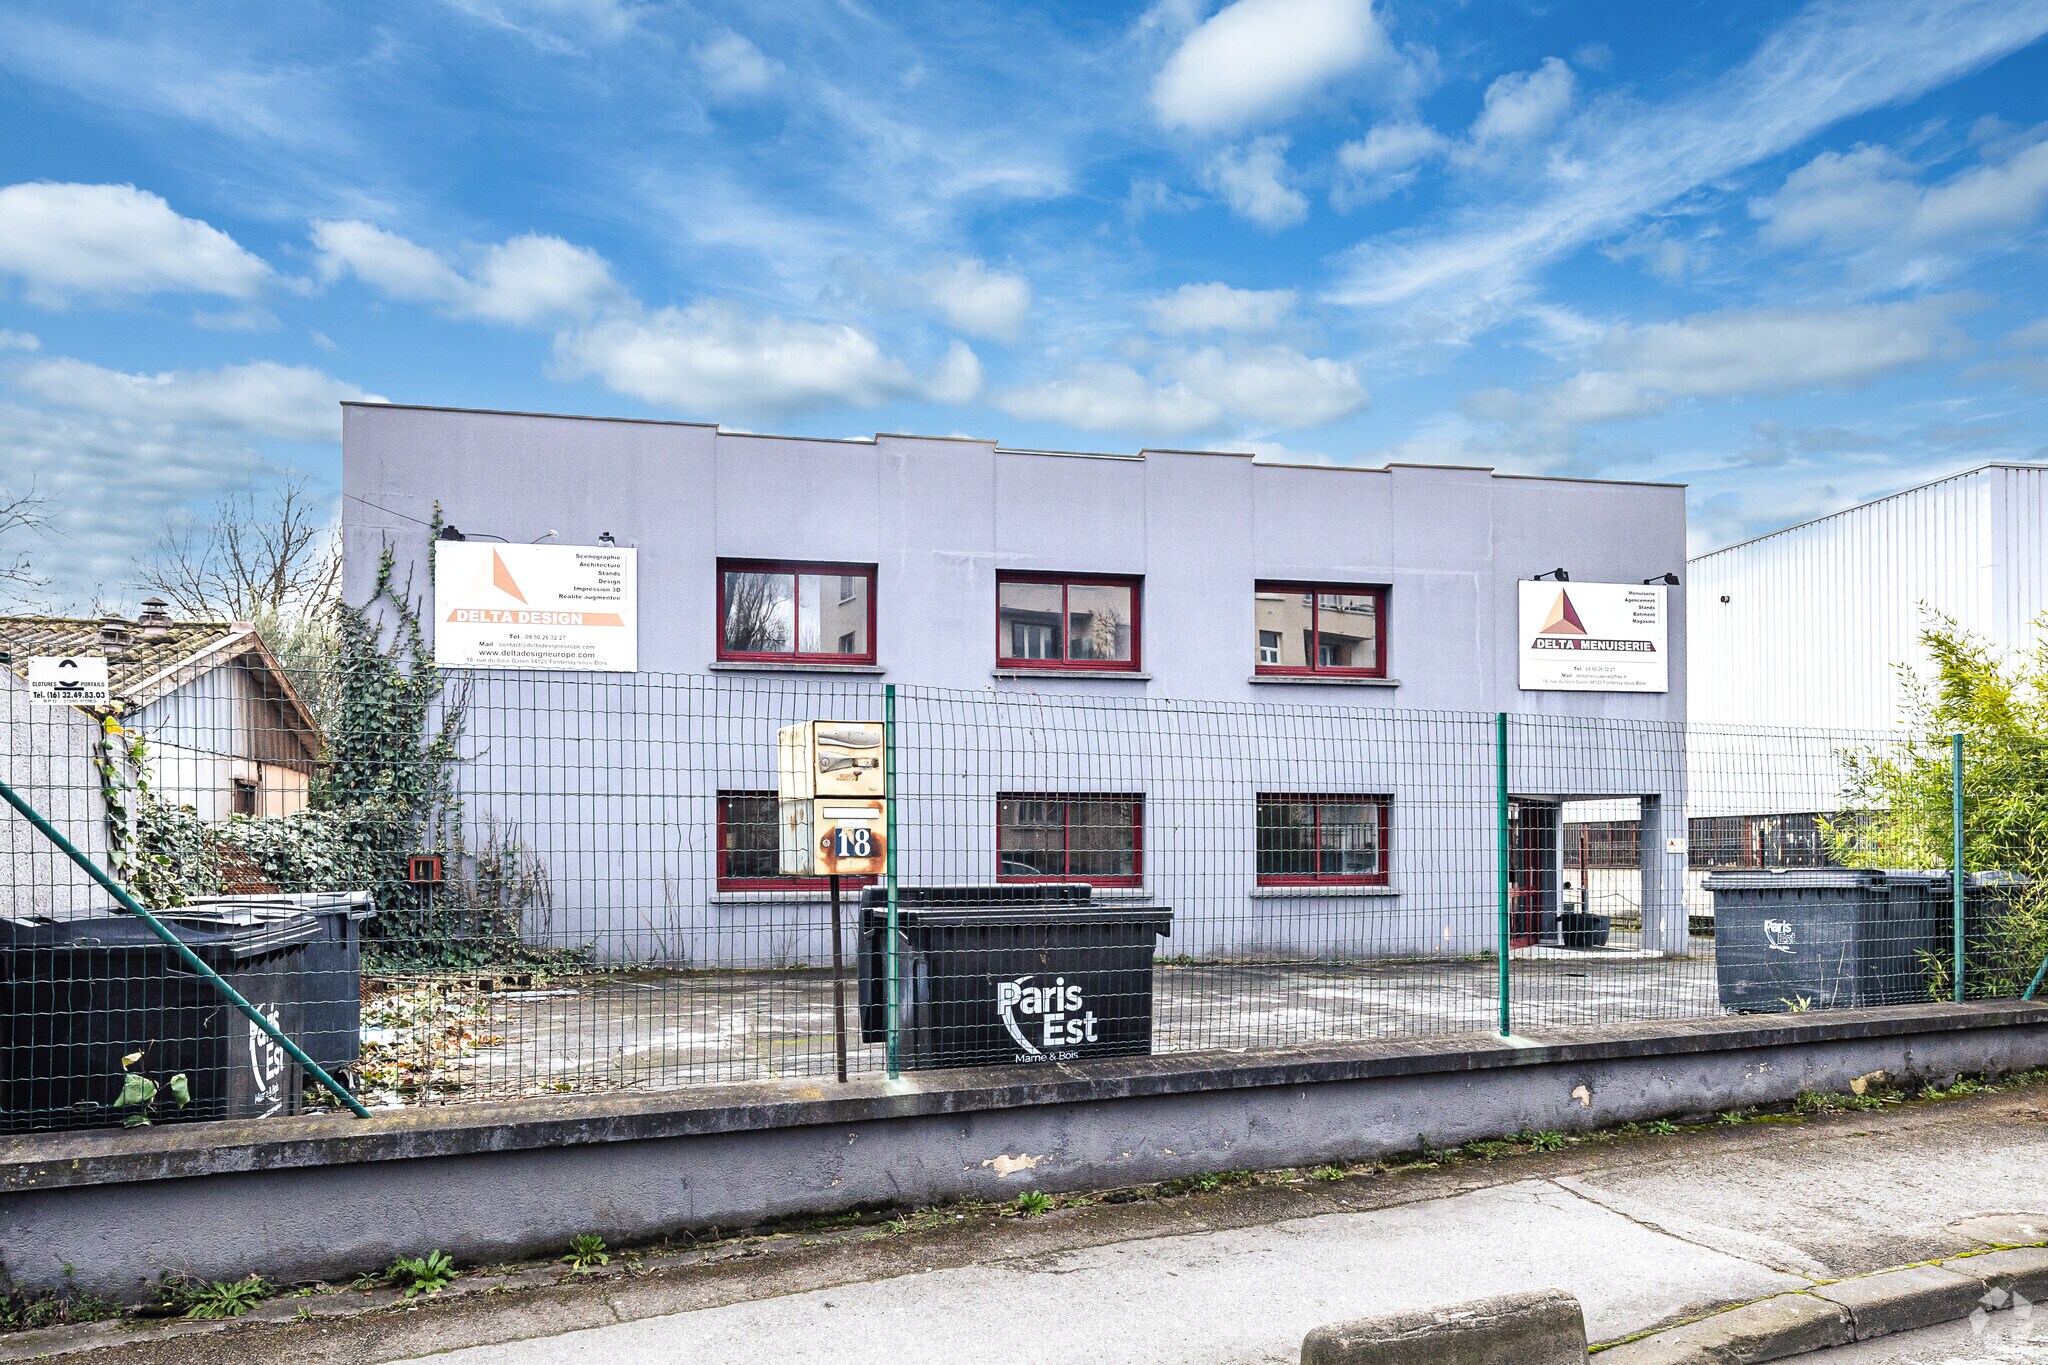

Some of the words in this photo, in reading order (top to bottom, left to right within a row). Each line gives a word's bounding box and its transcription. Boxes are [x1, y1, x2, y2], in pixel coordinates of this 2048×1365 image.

[456, 609, 514, 624] DELTA
[518, 611, 583, 625] DESIGN
[1536, 639, 1575, 649] DELTA
[1580, 640, 1651, 651] MENUISERIE
[478, 650, 595, 659] www.deltadesigneurope.com
[46, 691, 60, 699] (16)
[838, 828, 871, 857] 18
[1764, 920, 1792, 933] Paris
[1777, 932, 1796, 944] Est
[997, 977, 1083, 1015] Paris
[1043, 1010, 1098, 1046] Est
[1015, 1053, 1047, 1063] Marne
[1050, 1052, 1057, 1061] &
[1058, 1050, 1079, 1060] Bois
